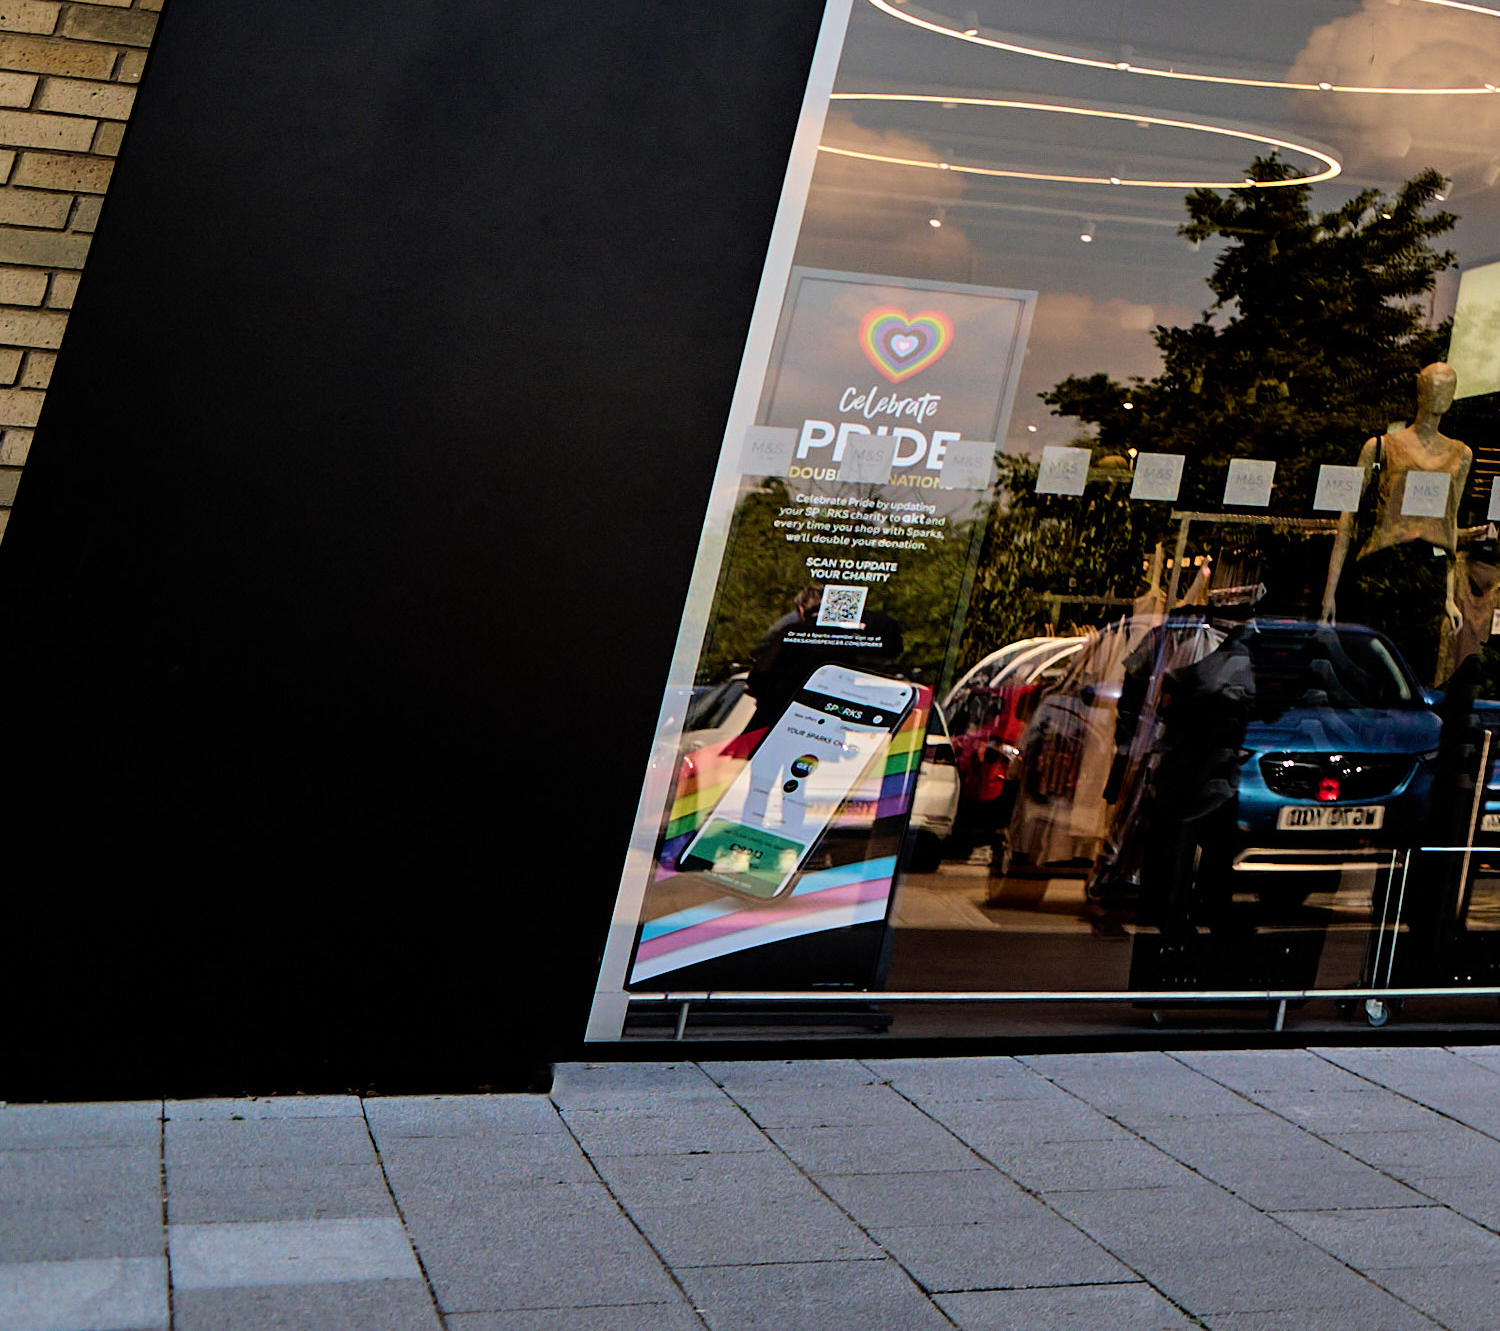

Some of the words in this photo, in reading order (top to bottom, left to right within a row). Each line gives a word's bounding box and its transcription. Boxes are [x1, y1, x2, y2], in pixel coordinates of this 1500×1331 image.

[838, 385, 942, 424] Celebrate
[751, 441, 784, 455] M&S
[796, 419, 962, 471] PRDE
[854, 448, 884, 461] M&S
[952, 454, 983, 467] M&S
[788, 465, 841, 481] DOUB
[1235, 473, 1263, 486] M&S
[1412, 484, 1440, 498] M&S
[795, 494, 847, 506] Celebrate
[849, 497, 876, 509] Pride
[876, 499, 890, 510] by
[890, 501, 936, 515] updating
[779, 507, 804, 517] your
[850, 510, 888, 524] charity
[889, 513, 900, 523] to
[902, 512, 926, 525] akt
[926, 516, 946, 527] and
[773, 519, 804, 530] every
[806, 520, 830, 531] time
[832, 523, 853, 534] you
[854, 524, 881, 536] shop
[883, 526, 905, 536] with
[812, 534, 850, 545] double
[850, 537, 877, 548] your
[806, 557, 838, 569] SCAN
[839, 559, 855, 570] TO
[855, 560, 898, 572] UPDATE
[810, 568, 840, 580] YOUR
[841, 570, 890, 583] CHARITY
